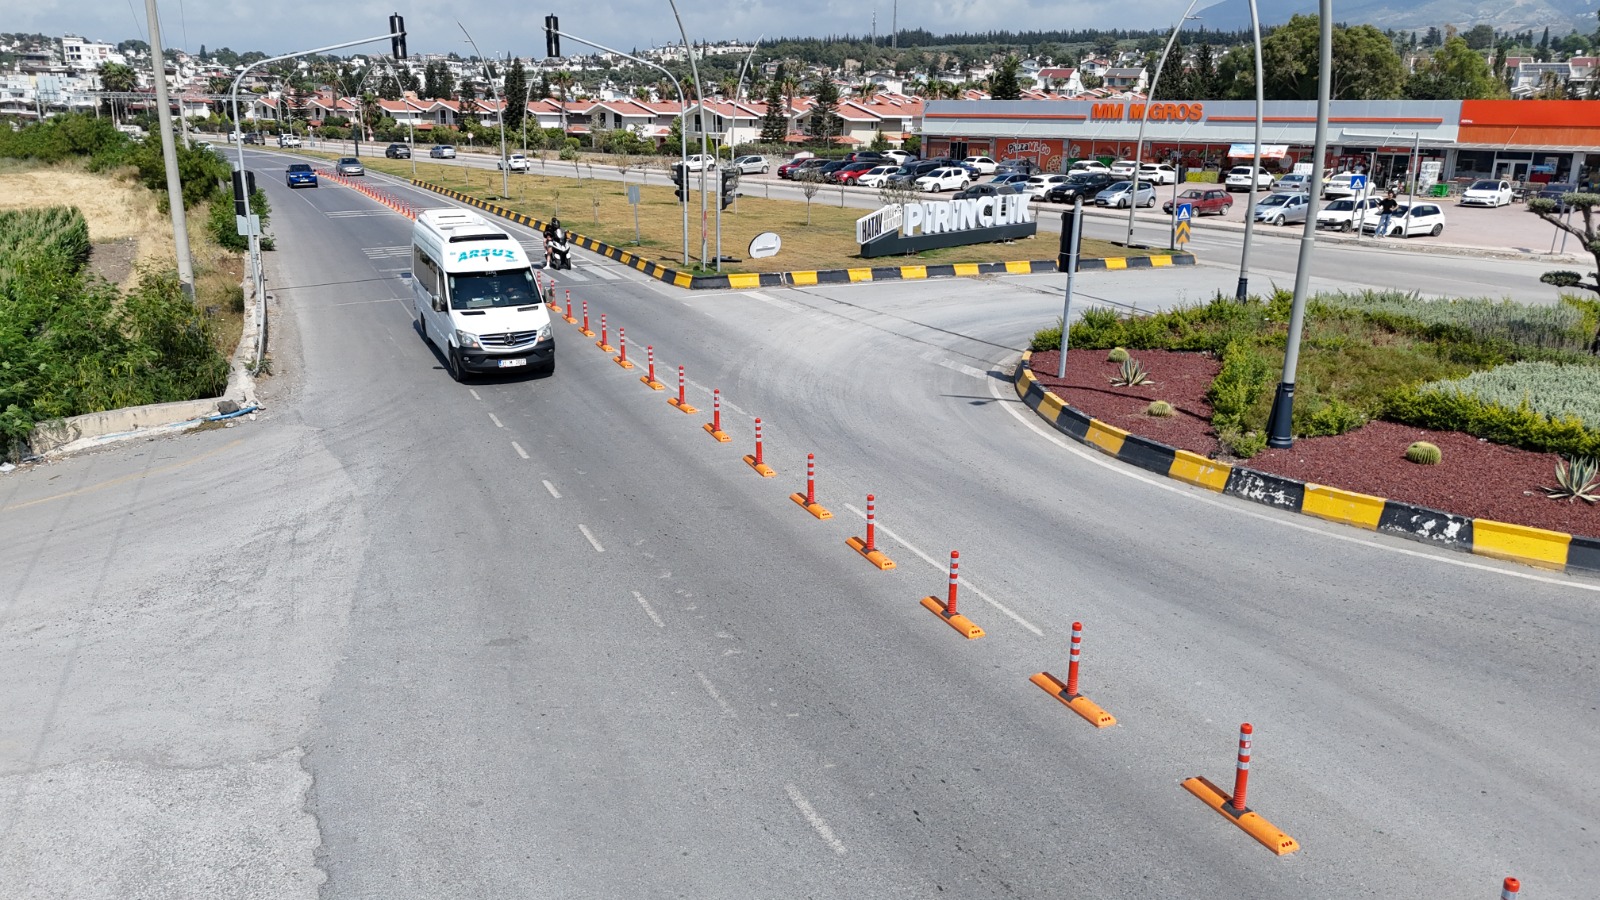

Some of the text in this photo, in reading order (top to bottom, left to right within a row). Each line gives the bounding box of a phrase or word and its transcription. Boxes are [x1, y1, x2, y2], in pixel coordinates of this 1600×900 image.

[1091, 103, 1203, 121] MM MGROS
[862, 212, 883, 243] HATAY
[457, 248, 515, 263] ARSUZ
